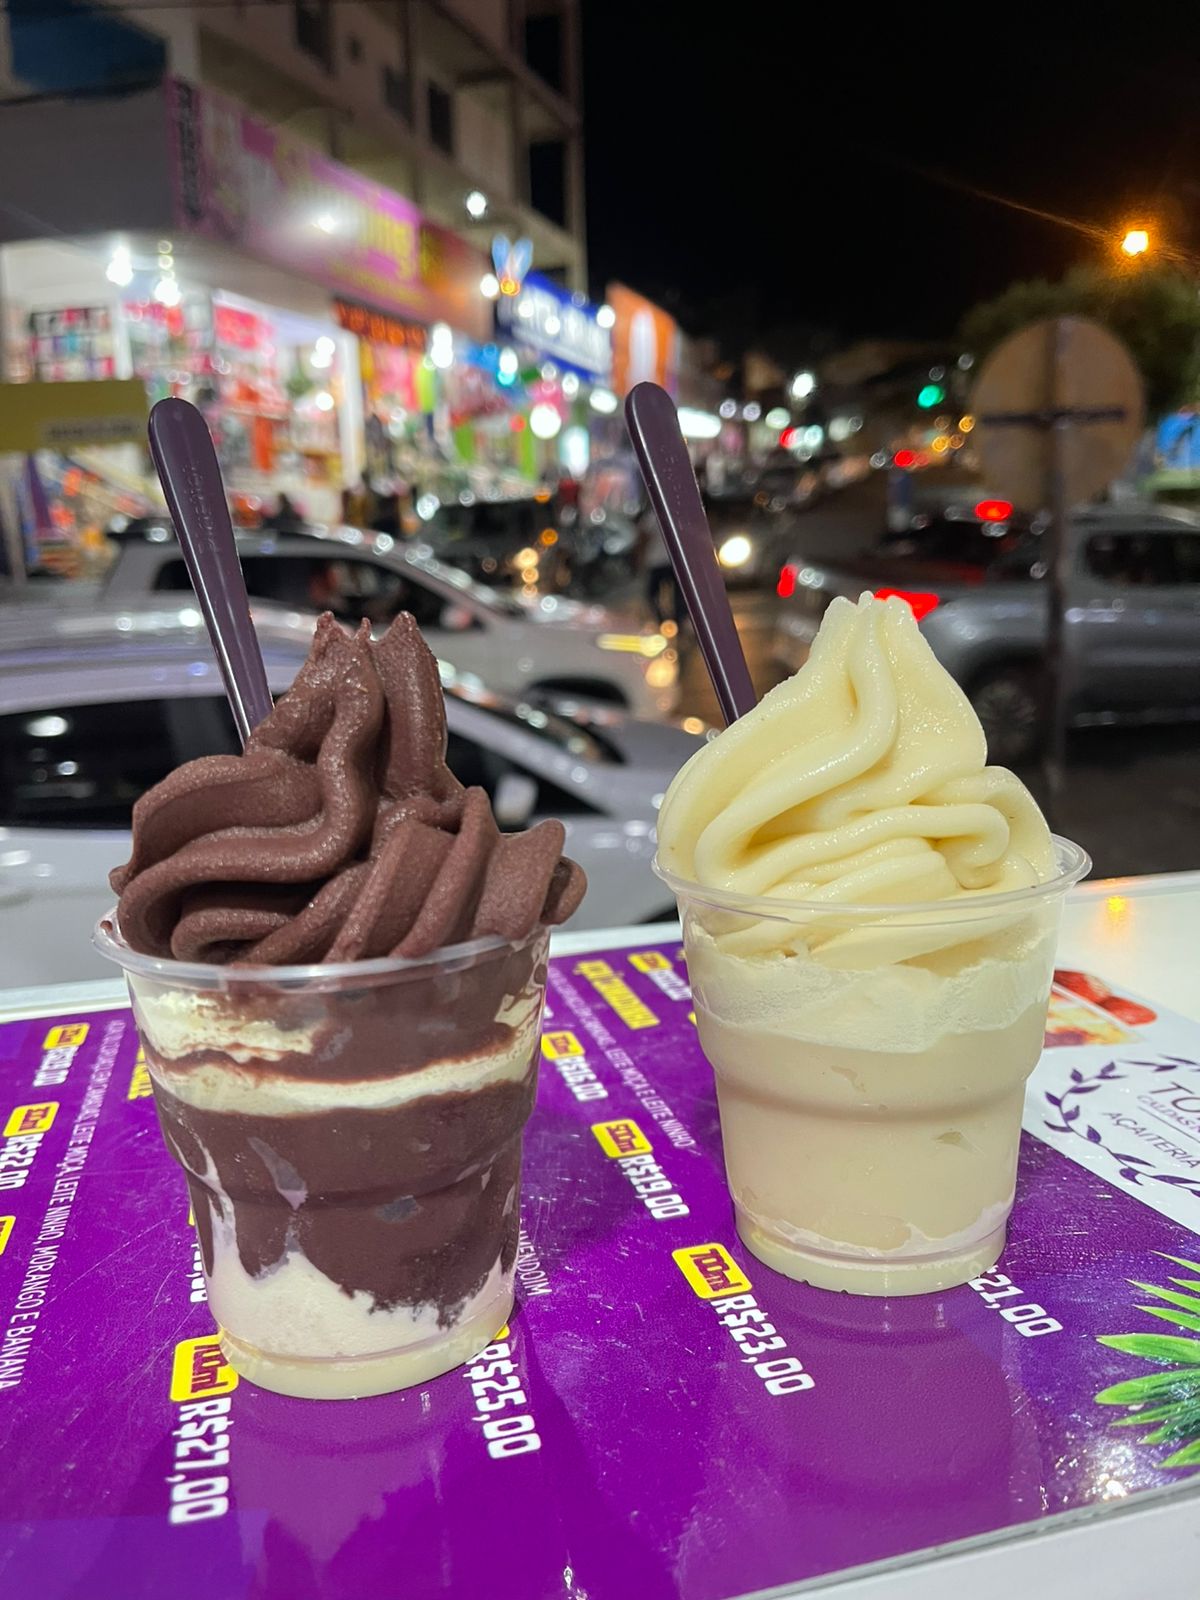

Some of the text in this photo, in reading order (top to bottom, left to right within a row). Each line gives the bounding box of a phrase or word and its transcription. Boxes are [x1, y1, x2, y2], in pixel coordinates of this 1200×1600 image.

[555, 1056, 609, 1101] R$16,00
[604, 1048, 635, 1069] LEITE
[620, 1067, 650, 1090] MOÇA
[641, 1096, 674, 1120] LEITE
[659, 1119, 696, 1147] NINHO
[1149, 1081, 1200, 1119] TO
[0, 1133, 45, 1191] R$2200
[69, 1120, 97, 1146] LEITE
[49, 1176, 80, 1206] LEITE
[606, 1124, 690, 1219] 500ml R$19,00
[32, 1205, 71, 1244] NINHO,
[15, 1245, 60, 1309] MORANGO
[517, 1229, 553, 1296] MENDOIM
[10, 1311, 40, 1324] E
[689, 1248, 815, 1396] 700ml R$23,00
[0, 1325, 37, 1389] BANANA
[463, 1343, 541, 1459] R$25,00
[165, 1397, 234, 1524] R$27,00
